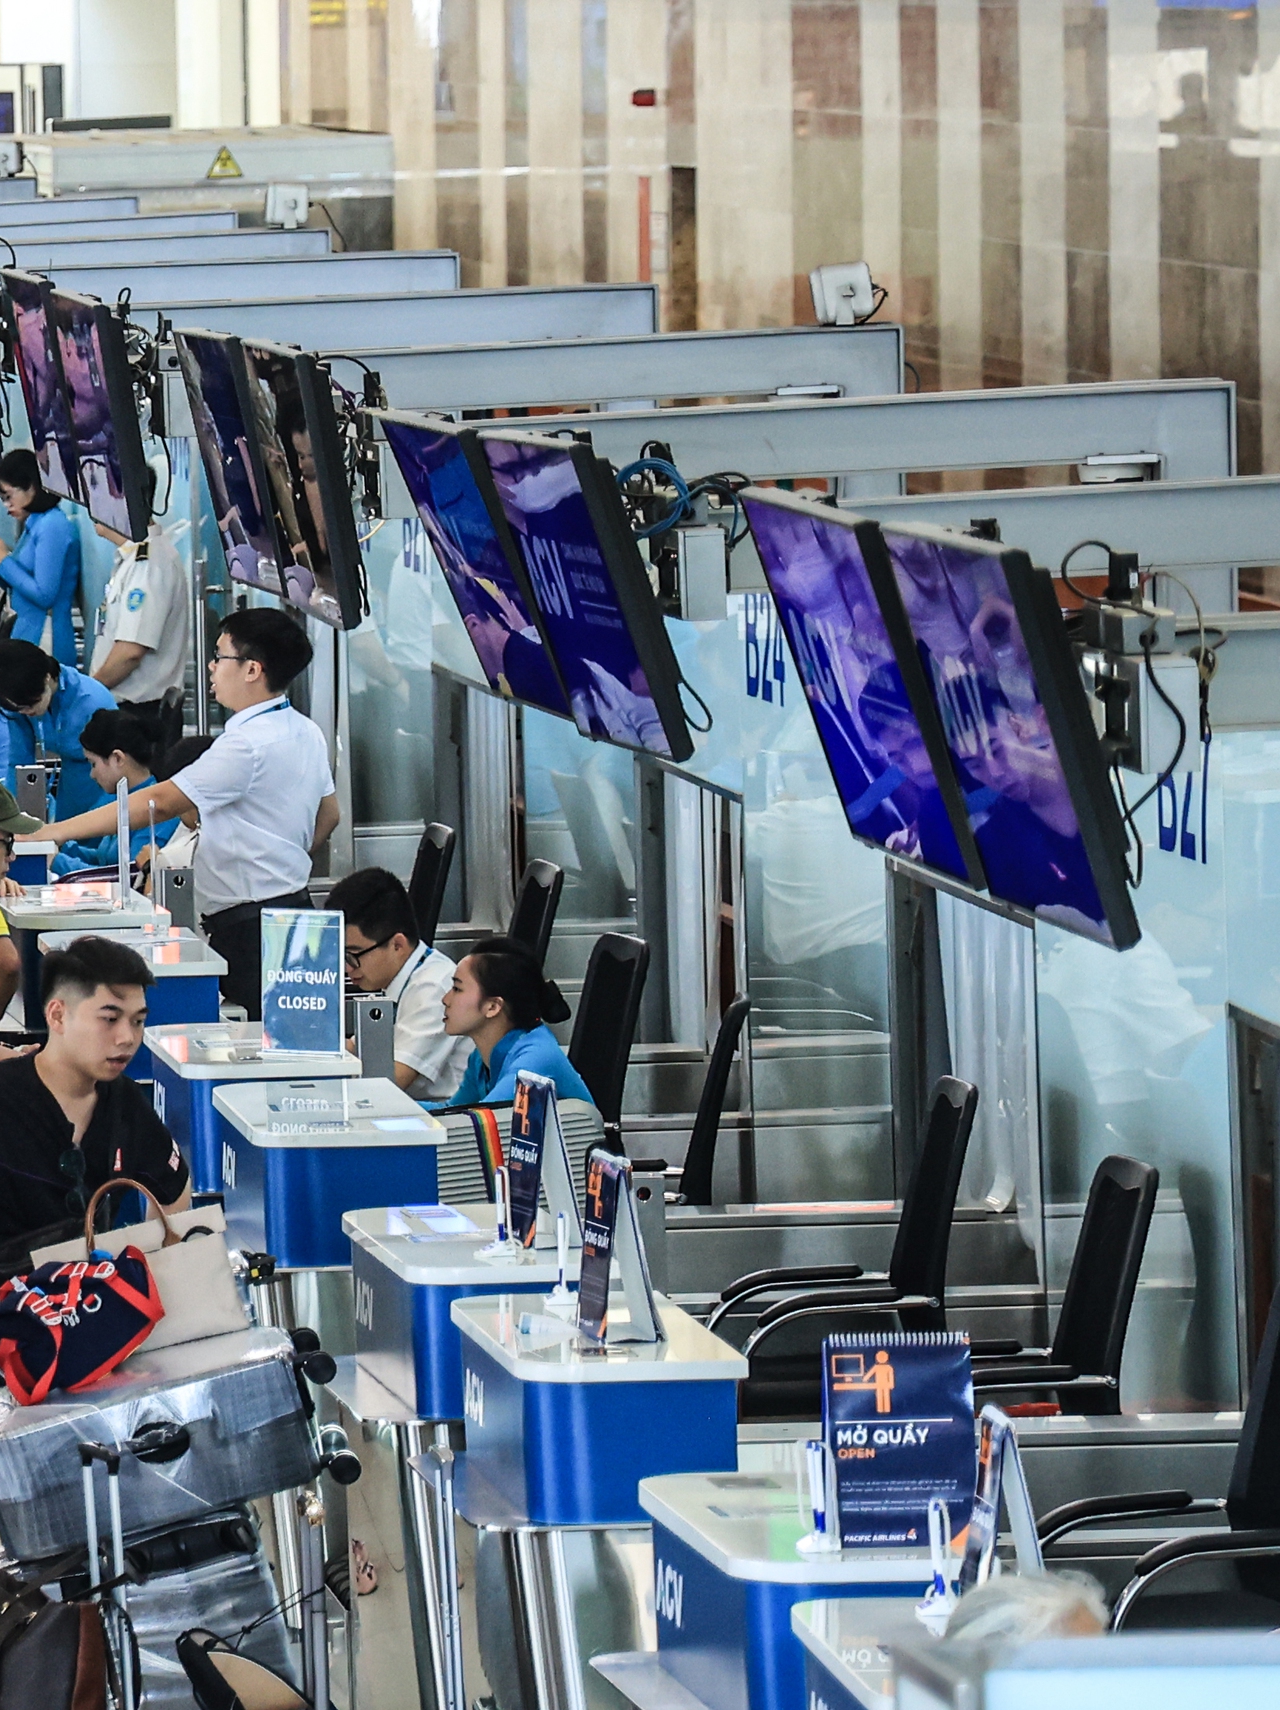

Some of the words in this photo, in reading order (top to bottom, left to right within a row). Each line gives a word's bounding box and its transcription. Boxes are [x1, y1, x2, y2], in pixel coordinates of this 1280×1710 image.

[745, 593, 785, 707] B24
[266, 967, 302, 984] ĐÓNG
[277, 995, 327, 1010] CLOSED
[356, 1276, 374, 1331] ACV
[465, 1367, 484, 1428] ACV
[836, 1424, 869, 1446] MỞ
[837, 1447, 876, 1460] OPEN
[843, 1534, 872, 1543] PACIFIC
[872, 1532, 907, 1542] AIRLINES
[656, 1558, 684, 1628] ACV
